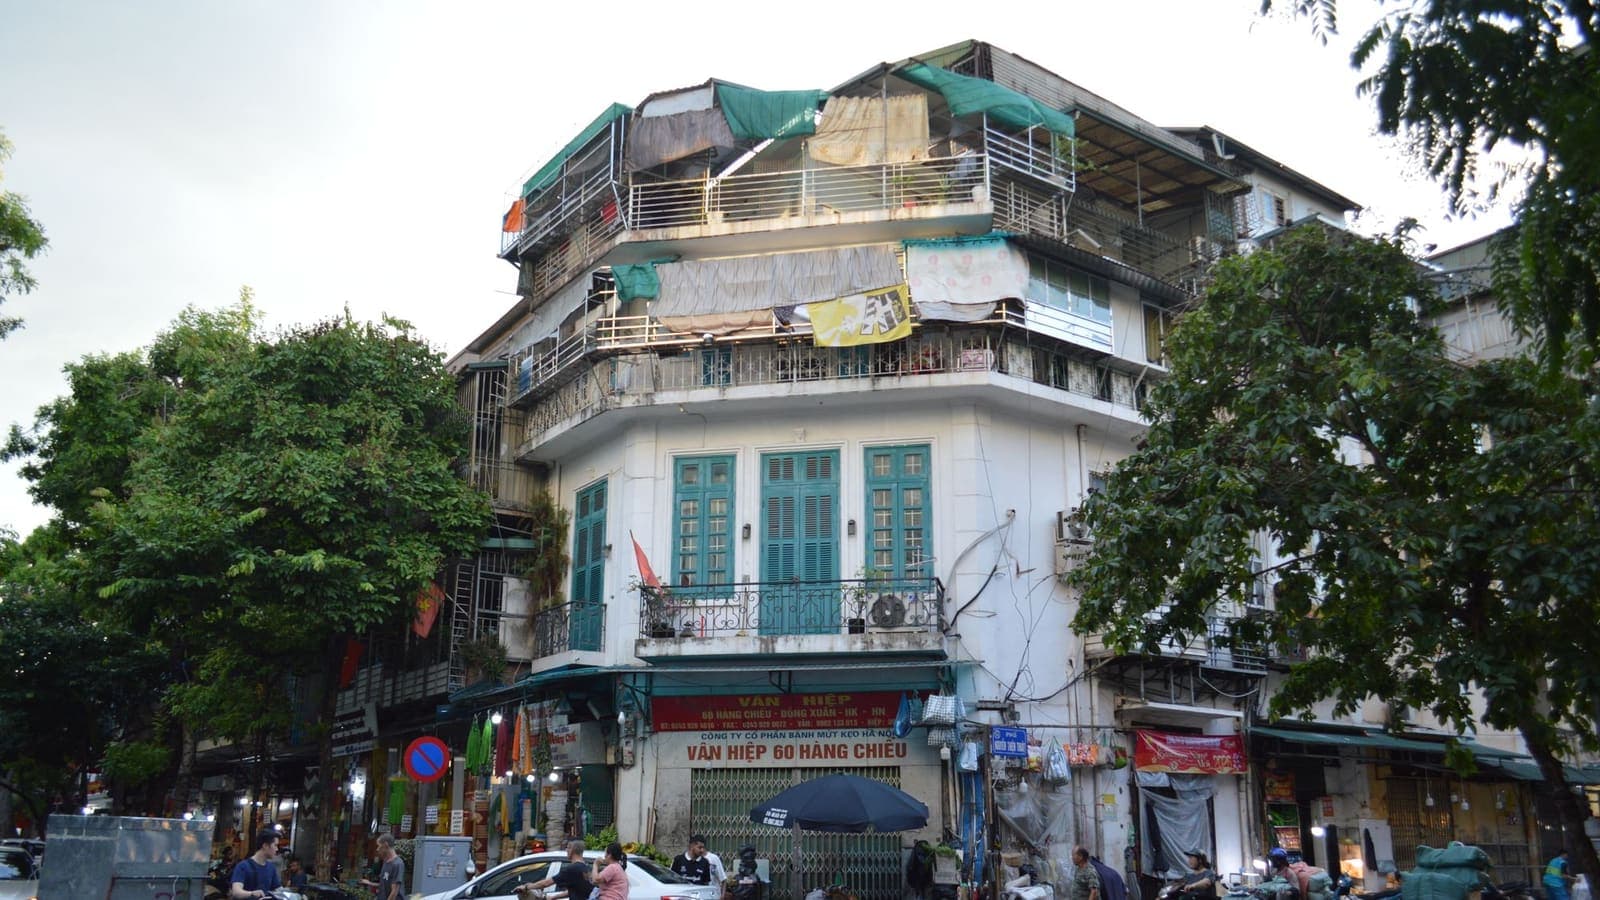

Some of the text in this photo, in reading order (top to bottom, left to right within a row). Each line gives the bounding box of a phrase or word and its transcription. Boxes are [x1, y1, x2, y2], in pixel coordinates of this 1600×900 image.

[738, 693, 851, 707] VÂN HIỆP
[717, 709, 742, 719] HÀNG
[701, 731, 727, 740] CÔNG
[730, 731, 742, 739] TY
[687, 736, 907, 763] VÂN HIỆP 60 HÀNG CHIẾU
